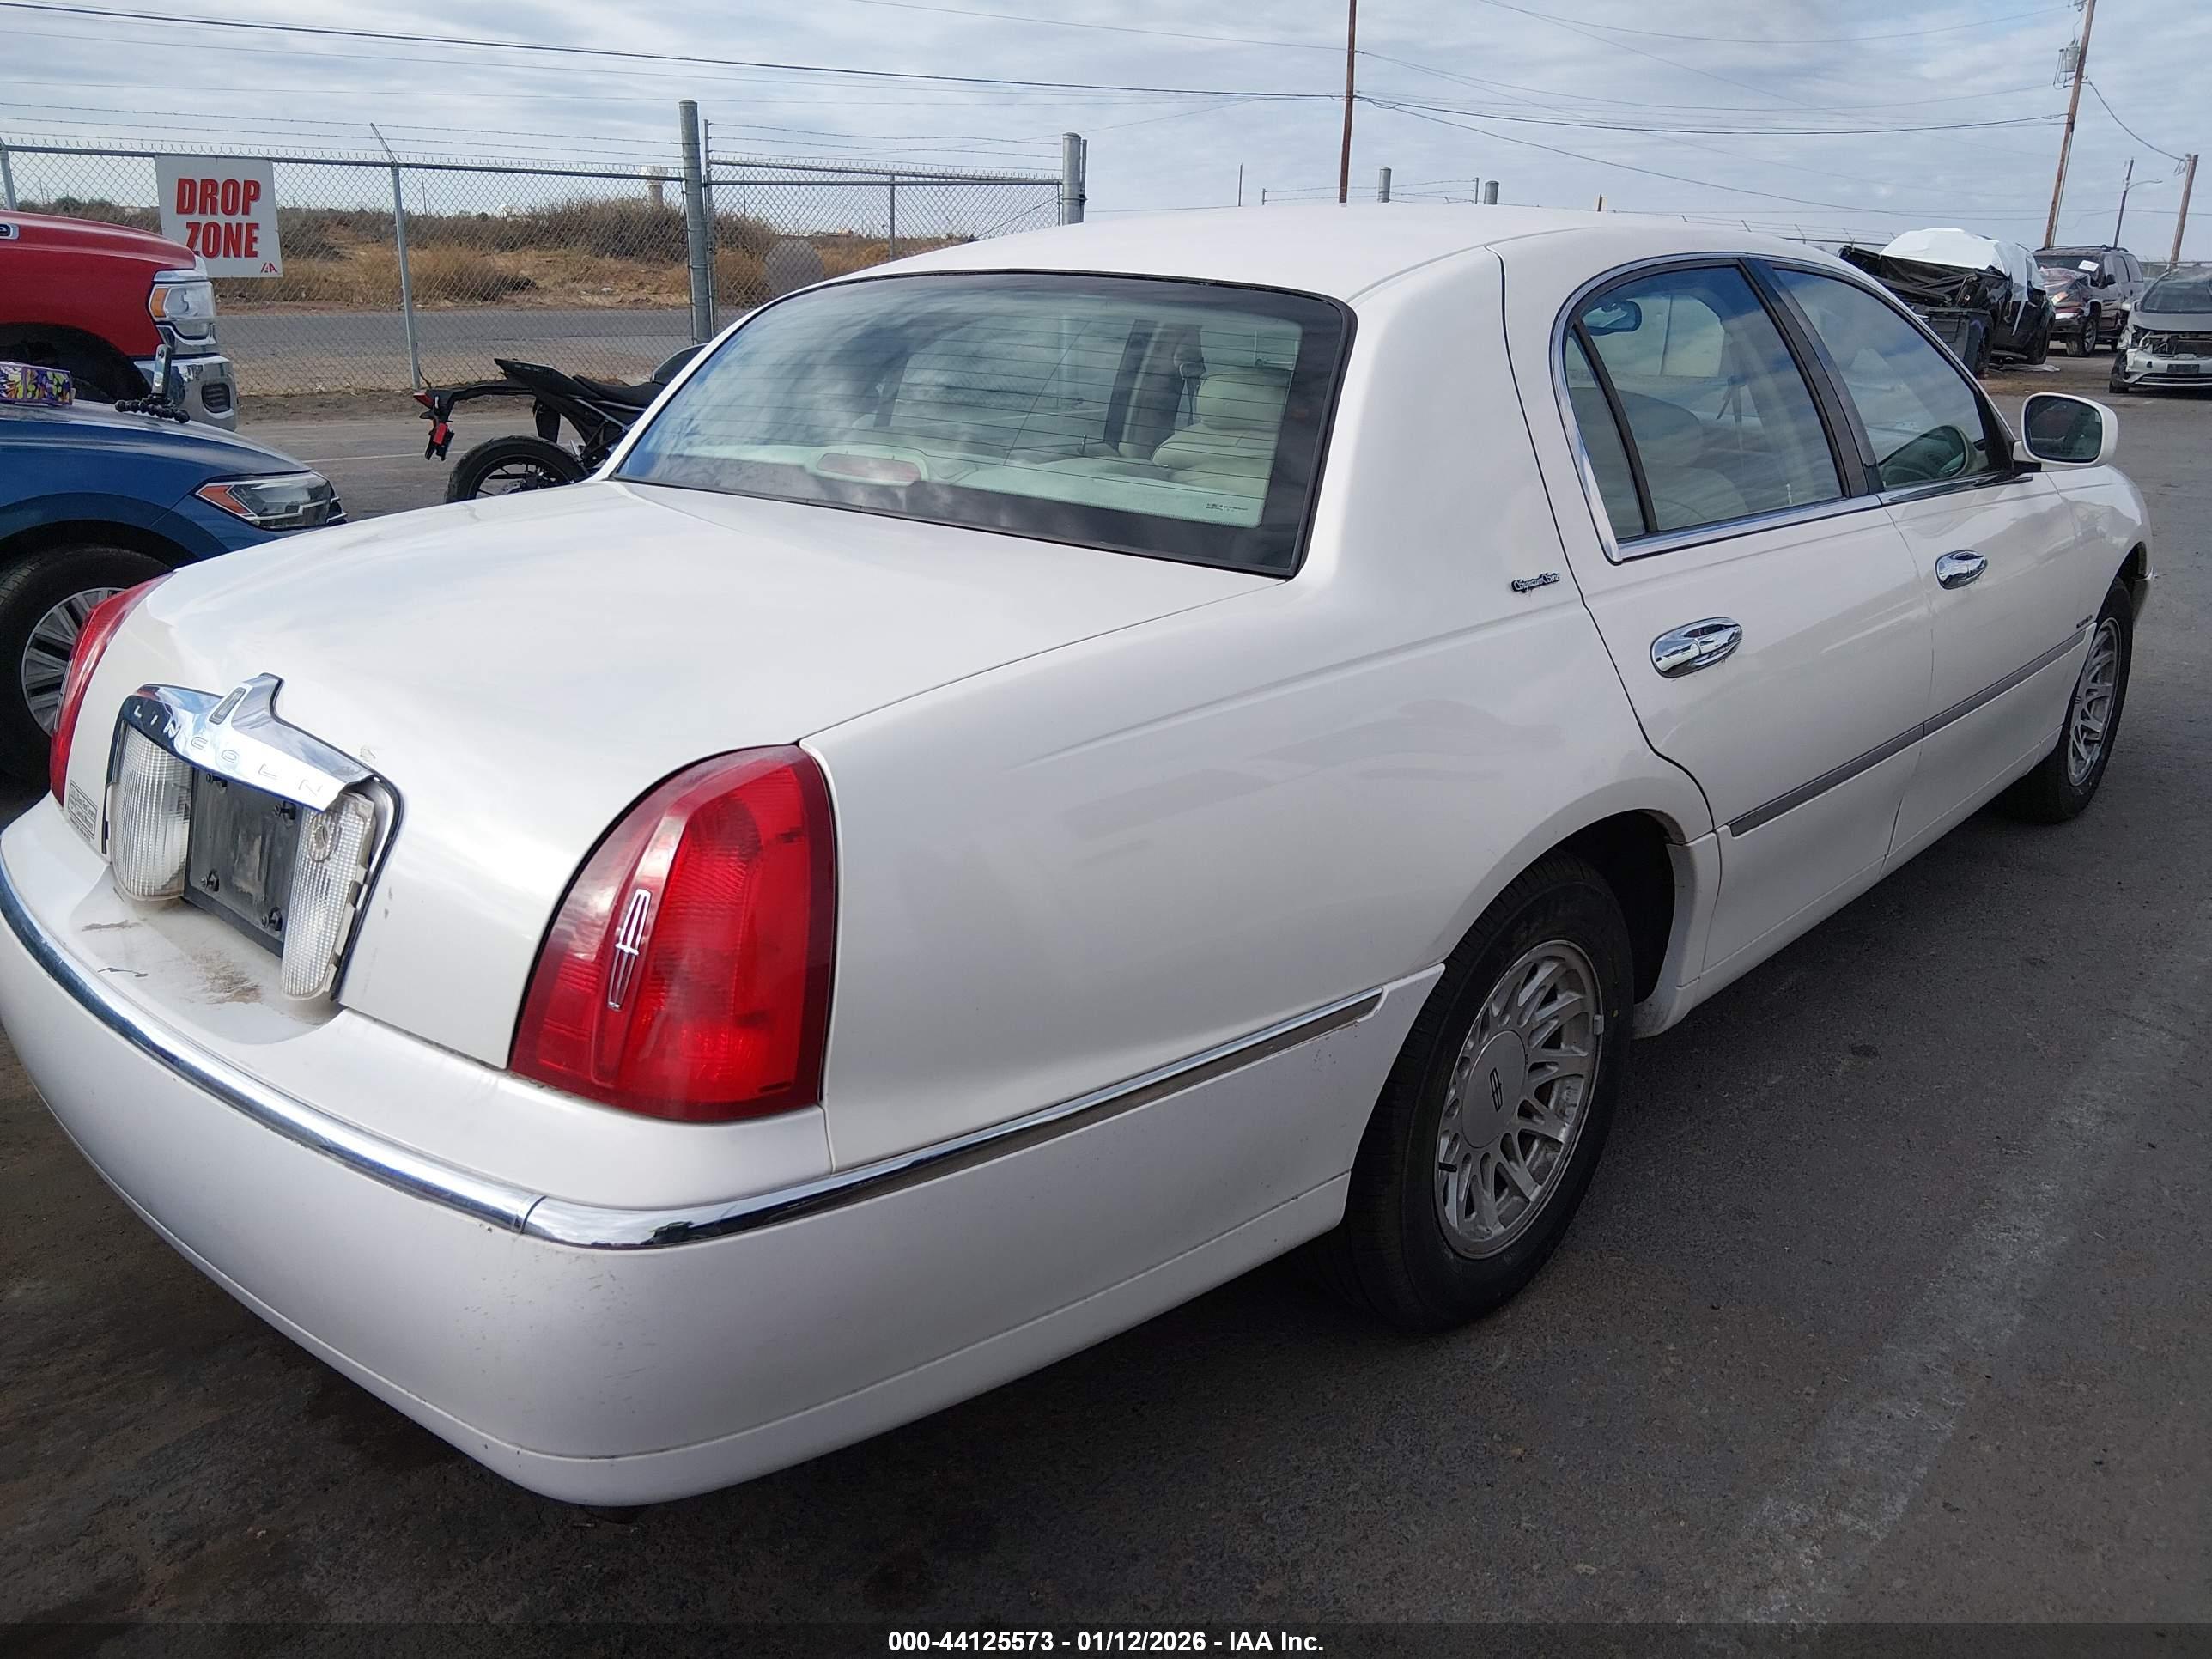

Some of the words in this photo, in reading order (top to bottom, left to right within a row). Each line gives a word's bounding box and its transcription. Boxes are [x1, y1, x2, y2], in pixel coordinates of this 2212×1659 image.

[176, 178, 261, 216] DROP
[185, 221, 259, 258] ZONE
[133, 704, 324, 797] LINCOLN
